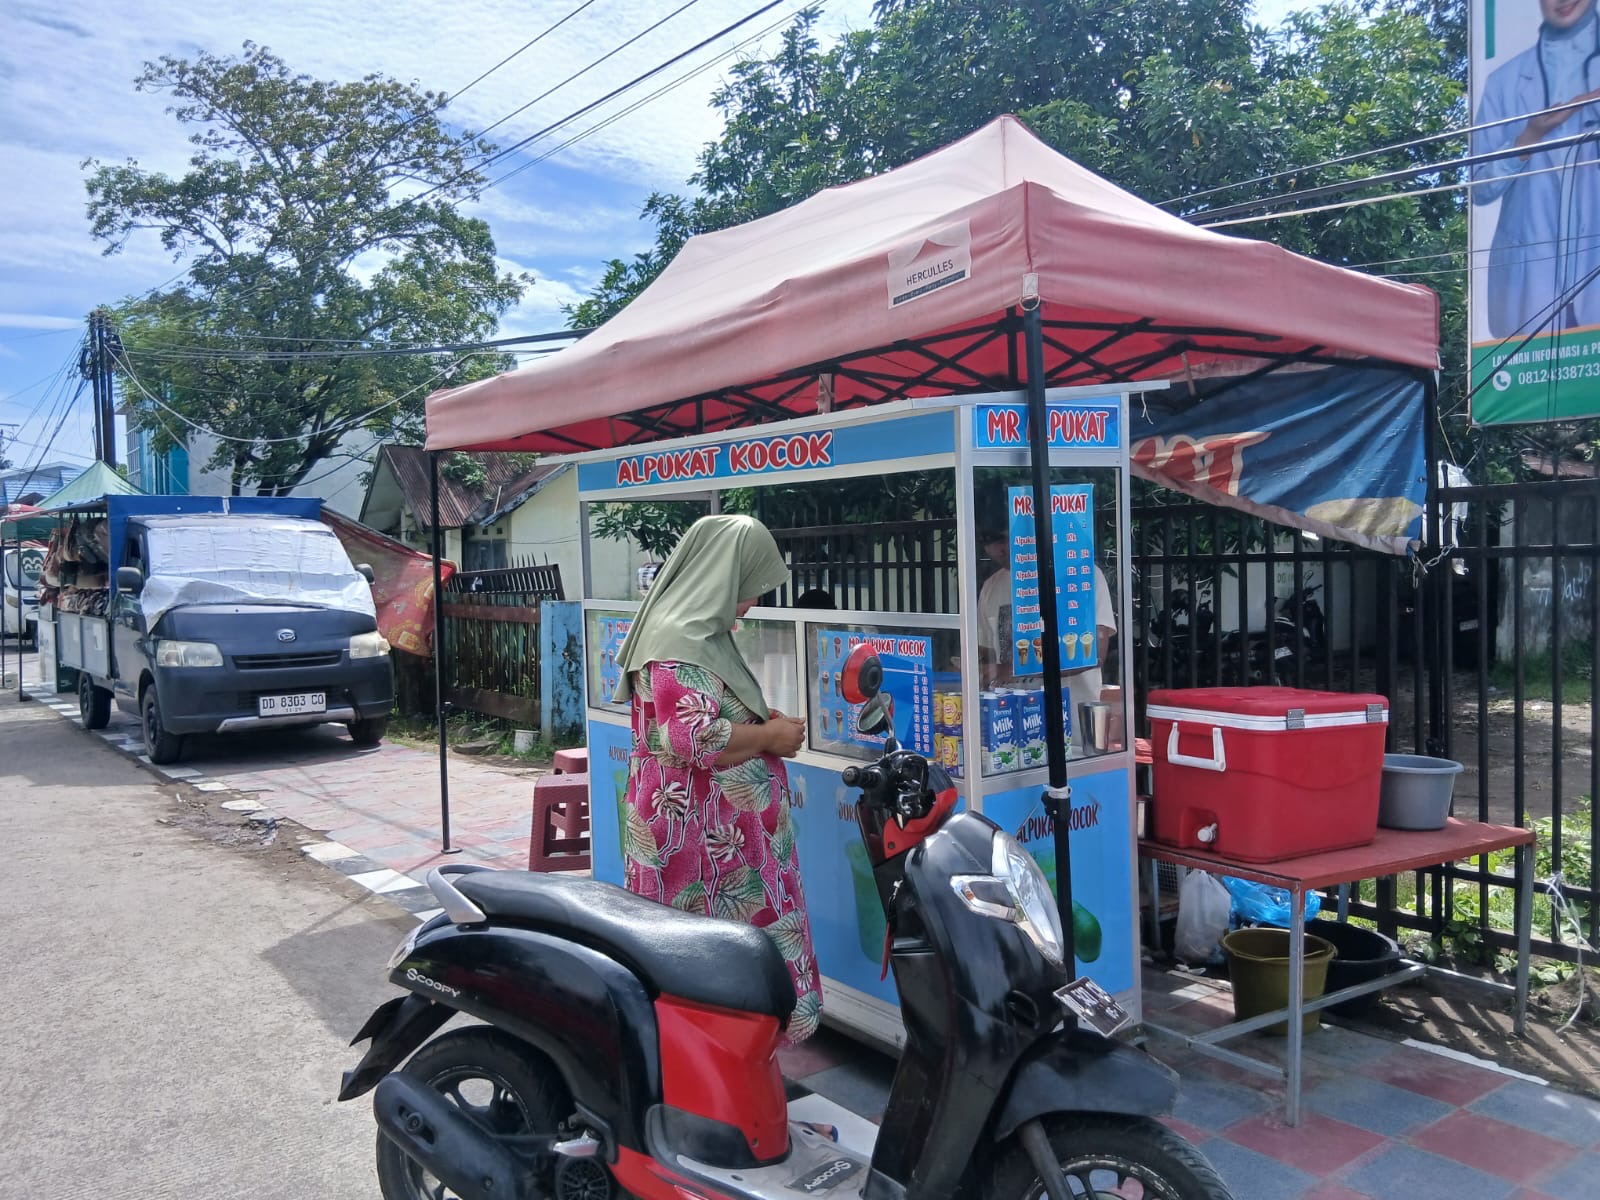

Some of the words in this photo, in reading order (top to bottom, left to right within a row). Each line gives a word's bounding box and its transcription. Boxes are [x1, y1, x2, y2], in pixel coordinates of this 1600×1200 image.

[906, 260, 954, 286] HERCULLES
[1492, 352, 1530, 367] LAYANAN
[1532, 345, 1580, 362] INFORMASI
[987, 409, 1021, 443] MR
[617, 446, 721, 486] ALPUKAT
[729, 431, 833, 474] KOCOK
[1014, 495, 1032, 516] MR
[898, 640, 926, 657] KOCOK
[262, 698, 275, 710] DD
[281, 695, 306, 708] 8303
[311, 694, 324, 705] CO
[993, 716, 1014, 735] Milk
[1023, 713, 1042, 731] Milk
[1016, 815, 1054, 843] ALPUKA
